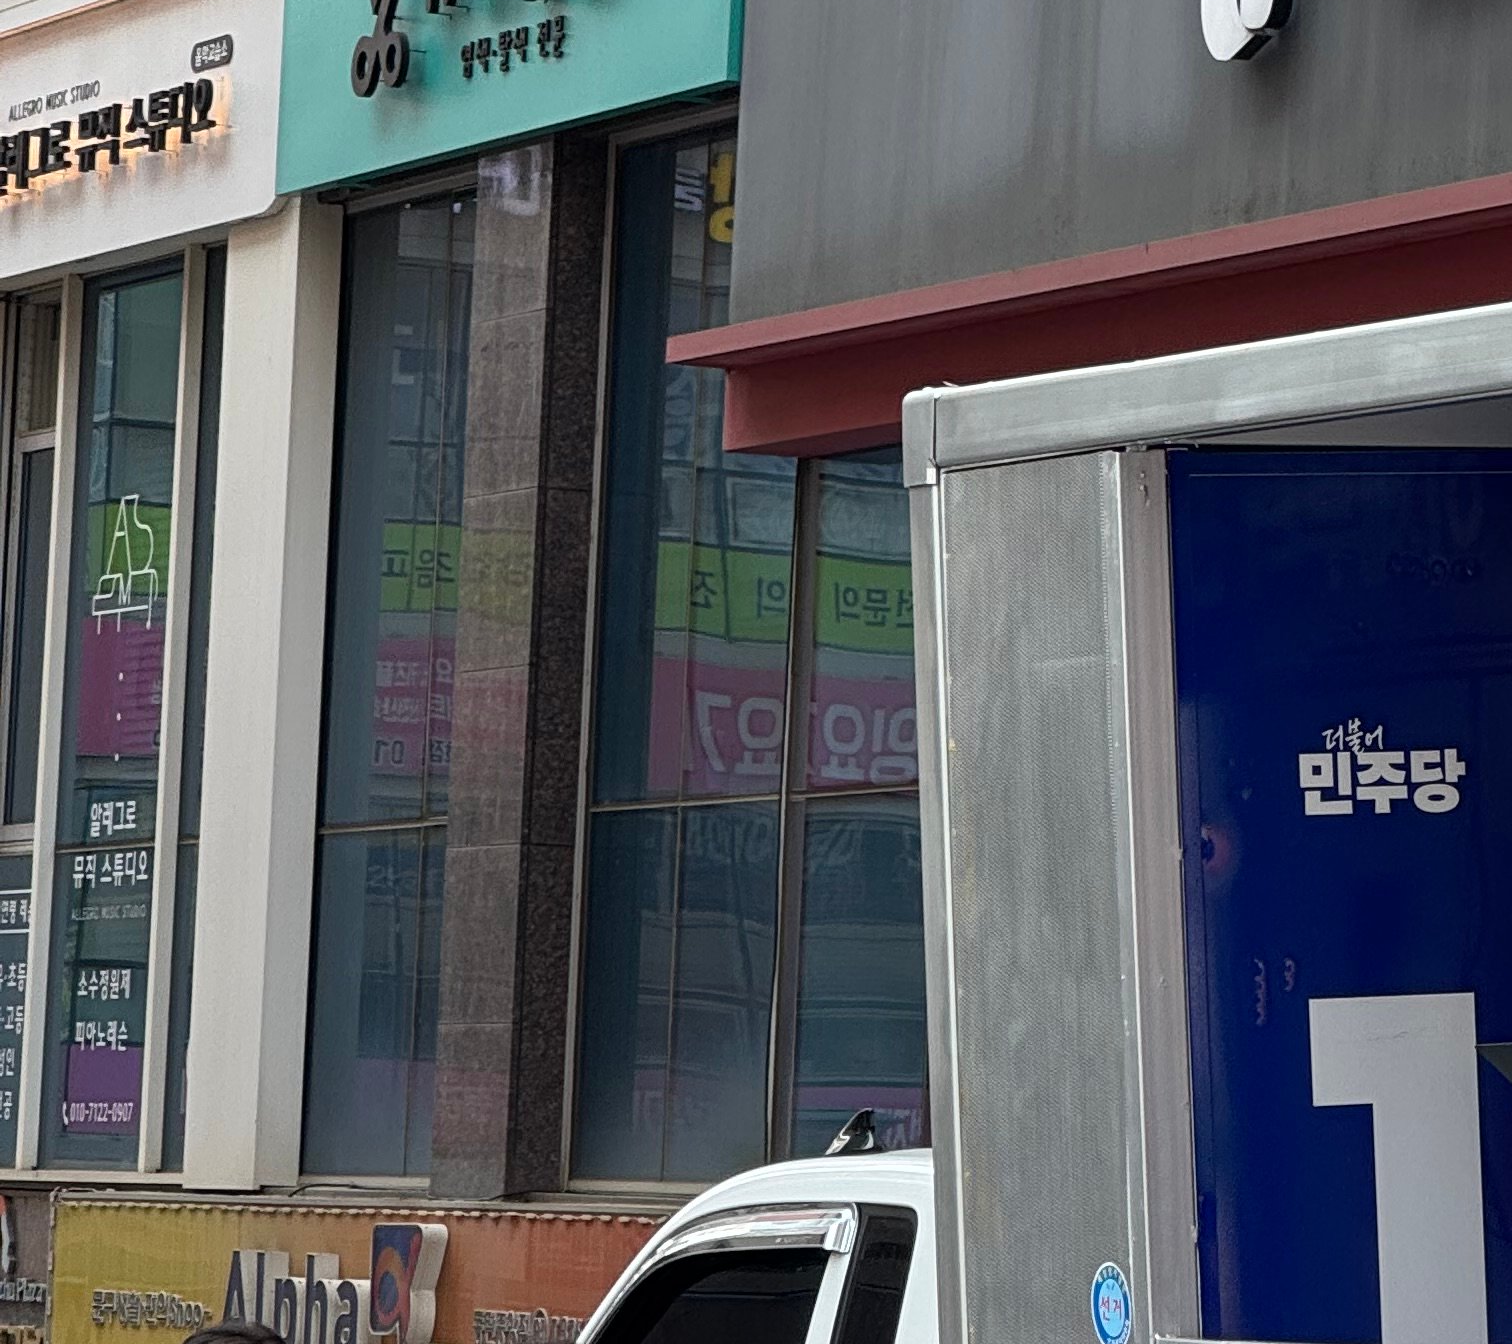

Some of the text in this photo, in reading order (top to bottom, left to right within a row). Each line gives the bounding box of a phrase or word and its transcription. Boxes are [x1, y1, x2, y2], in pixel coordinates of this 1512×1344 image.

[9, 80, 100, 122] ALLEGRO MUSIC STUDIO
[123, 78, 216, 153] 스튜디오
[1322, 719, 1384, 754] 더불어
[1298, 749, 1466, 816] 민주당
[91, 801, 137, 837] 알레그로
[73, 851, 148, 888] 뮤직 스튜디오
[77, 969, 131, 1000] 소수정원제
[75, 1021, 128, 1051] 피아노레슨
